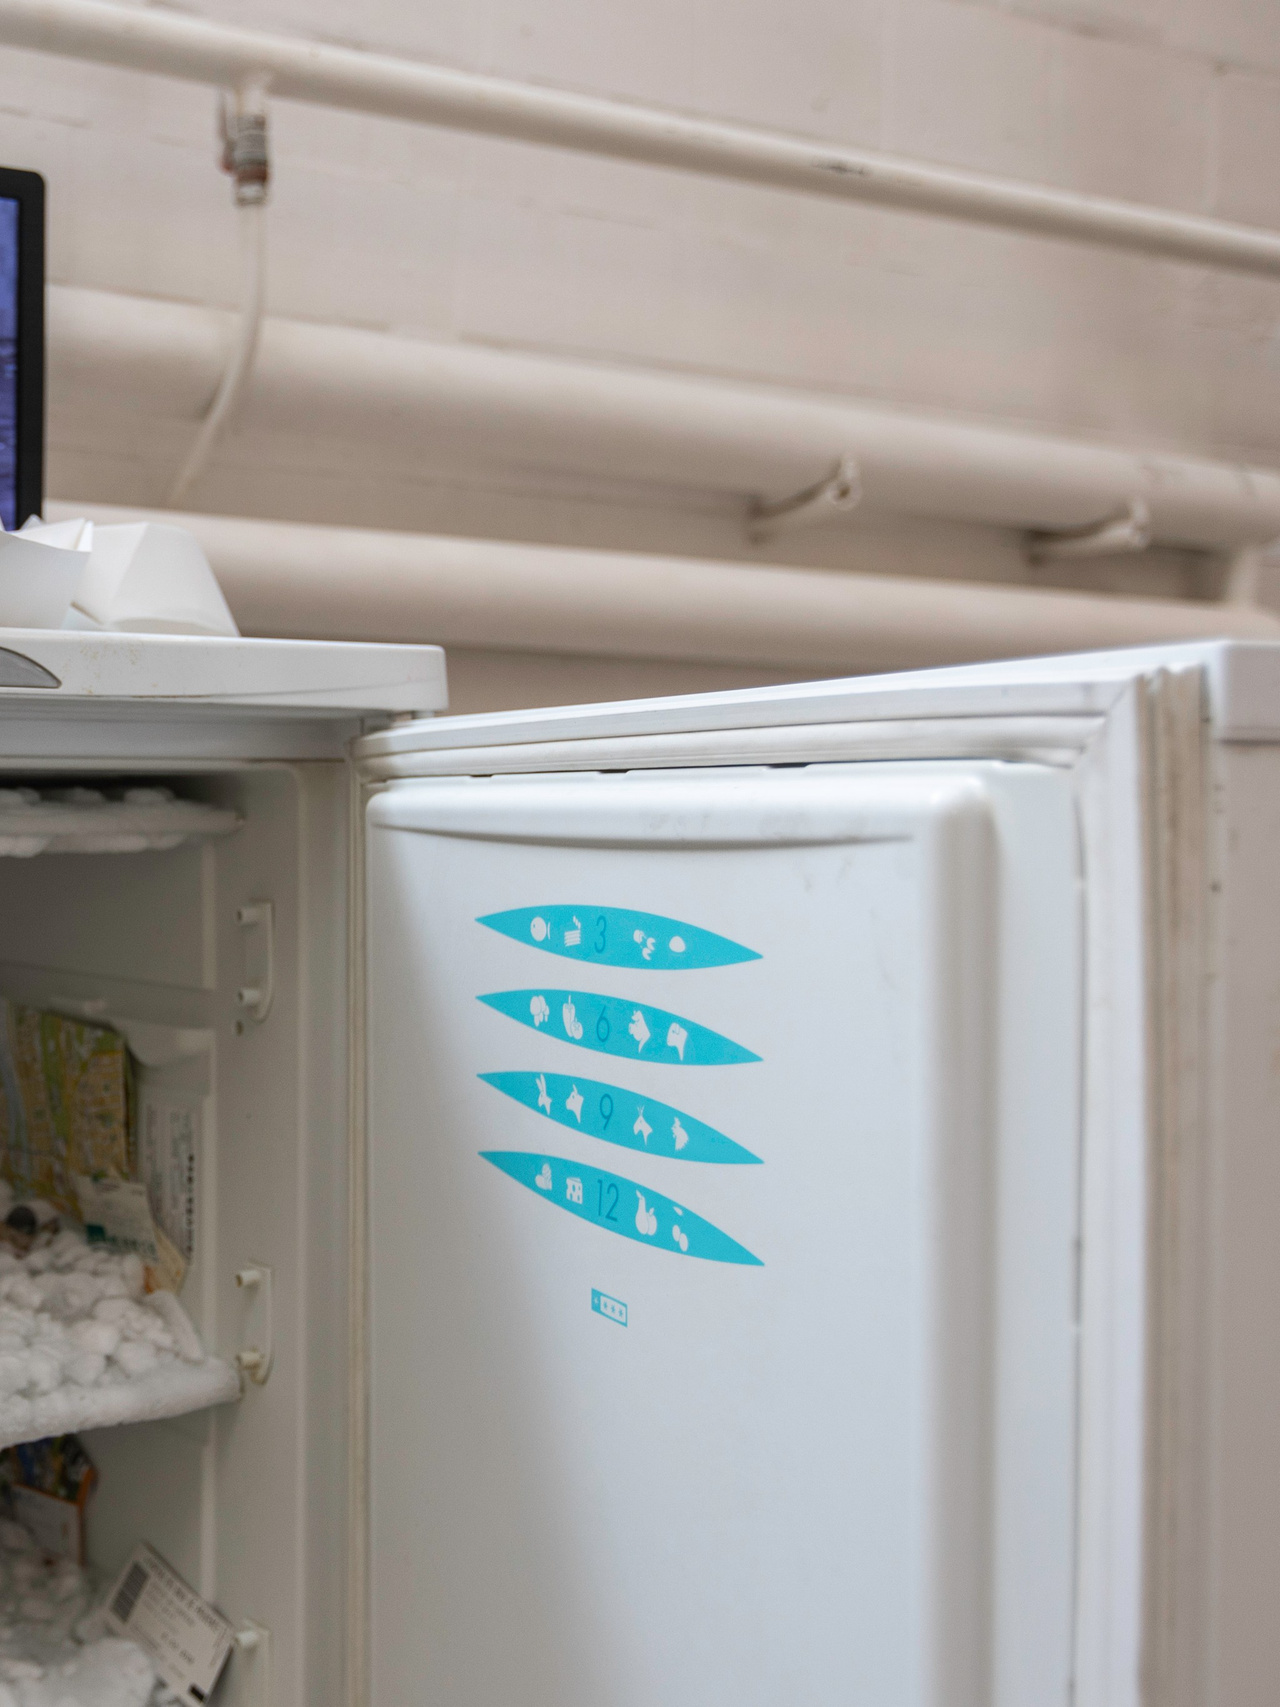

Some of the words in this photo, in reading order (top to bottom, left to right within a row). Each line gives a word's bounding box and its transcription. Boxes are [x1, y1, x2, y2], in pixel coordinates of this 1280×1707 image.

[594, 915, 608, 953] 3
[596, 1004, 610, 1043] 6
[599, 1093, 614, 1131] 9
[597, 1179, 620, 1222] 12
